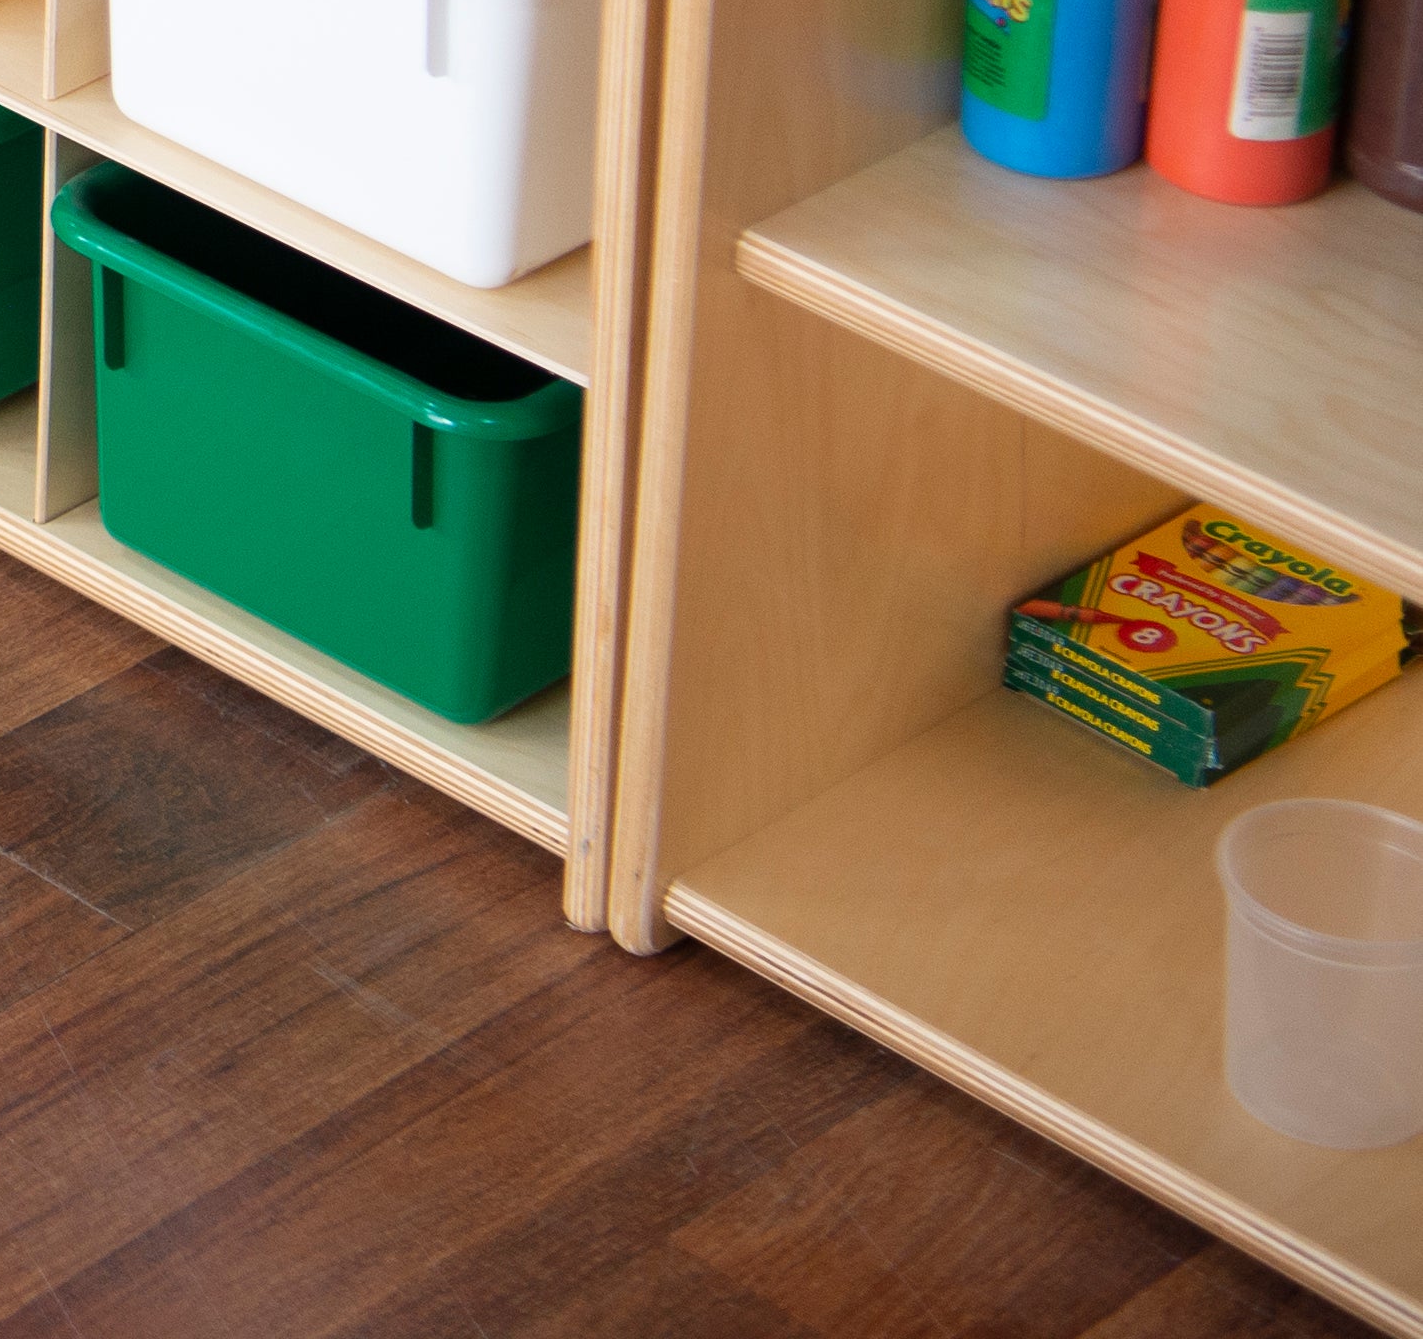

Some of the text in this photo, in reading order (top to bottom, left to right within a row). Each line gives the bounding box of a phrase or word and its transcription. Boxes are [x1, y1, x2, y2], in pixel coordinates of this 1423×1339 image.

[1204, 520, 1353, 596] Crayola
[1109, 574, 1267, 654] CRAYONS
[1130, 627, 1163, 645] 8
